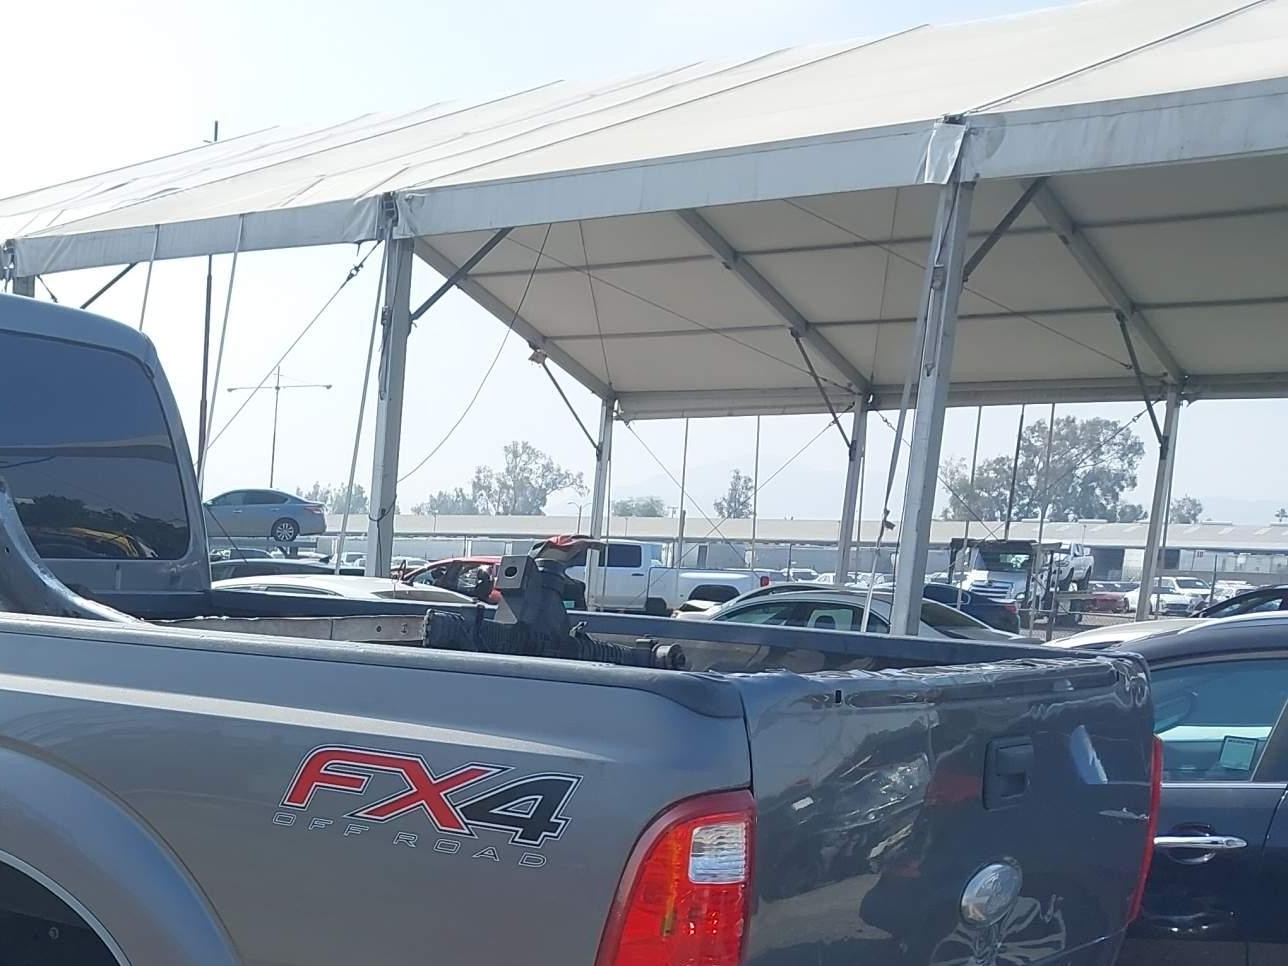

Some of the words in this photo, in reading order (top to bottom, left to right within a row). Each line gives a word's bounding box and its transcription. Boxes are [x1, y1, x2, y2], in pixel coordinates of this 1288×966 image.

[278, 743, 584, 849] FX4
[272, 811, 370, 837] OFF
[393, 831, 548, 869] ROAD
